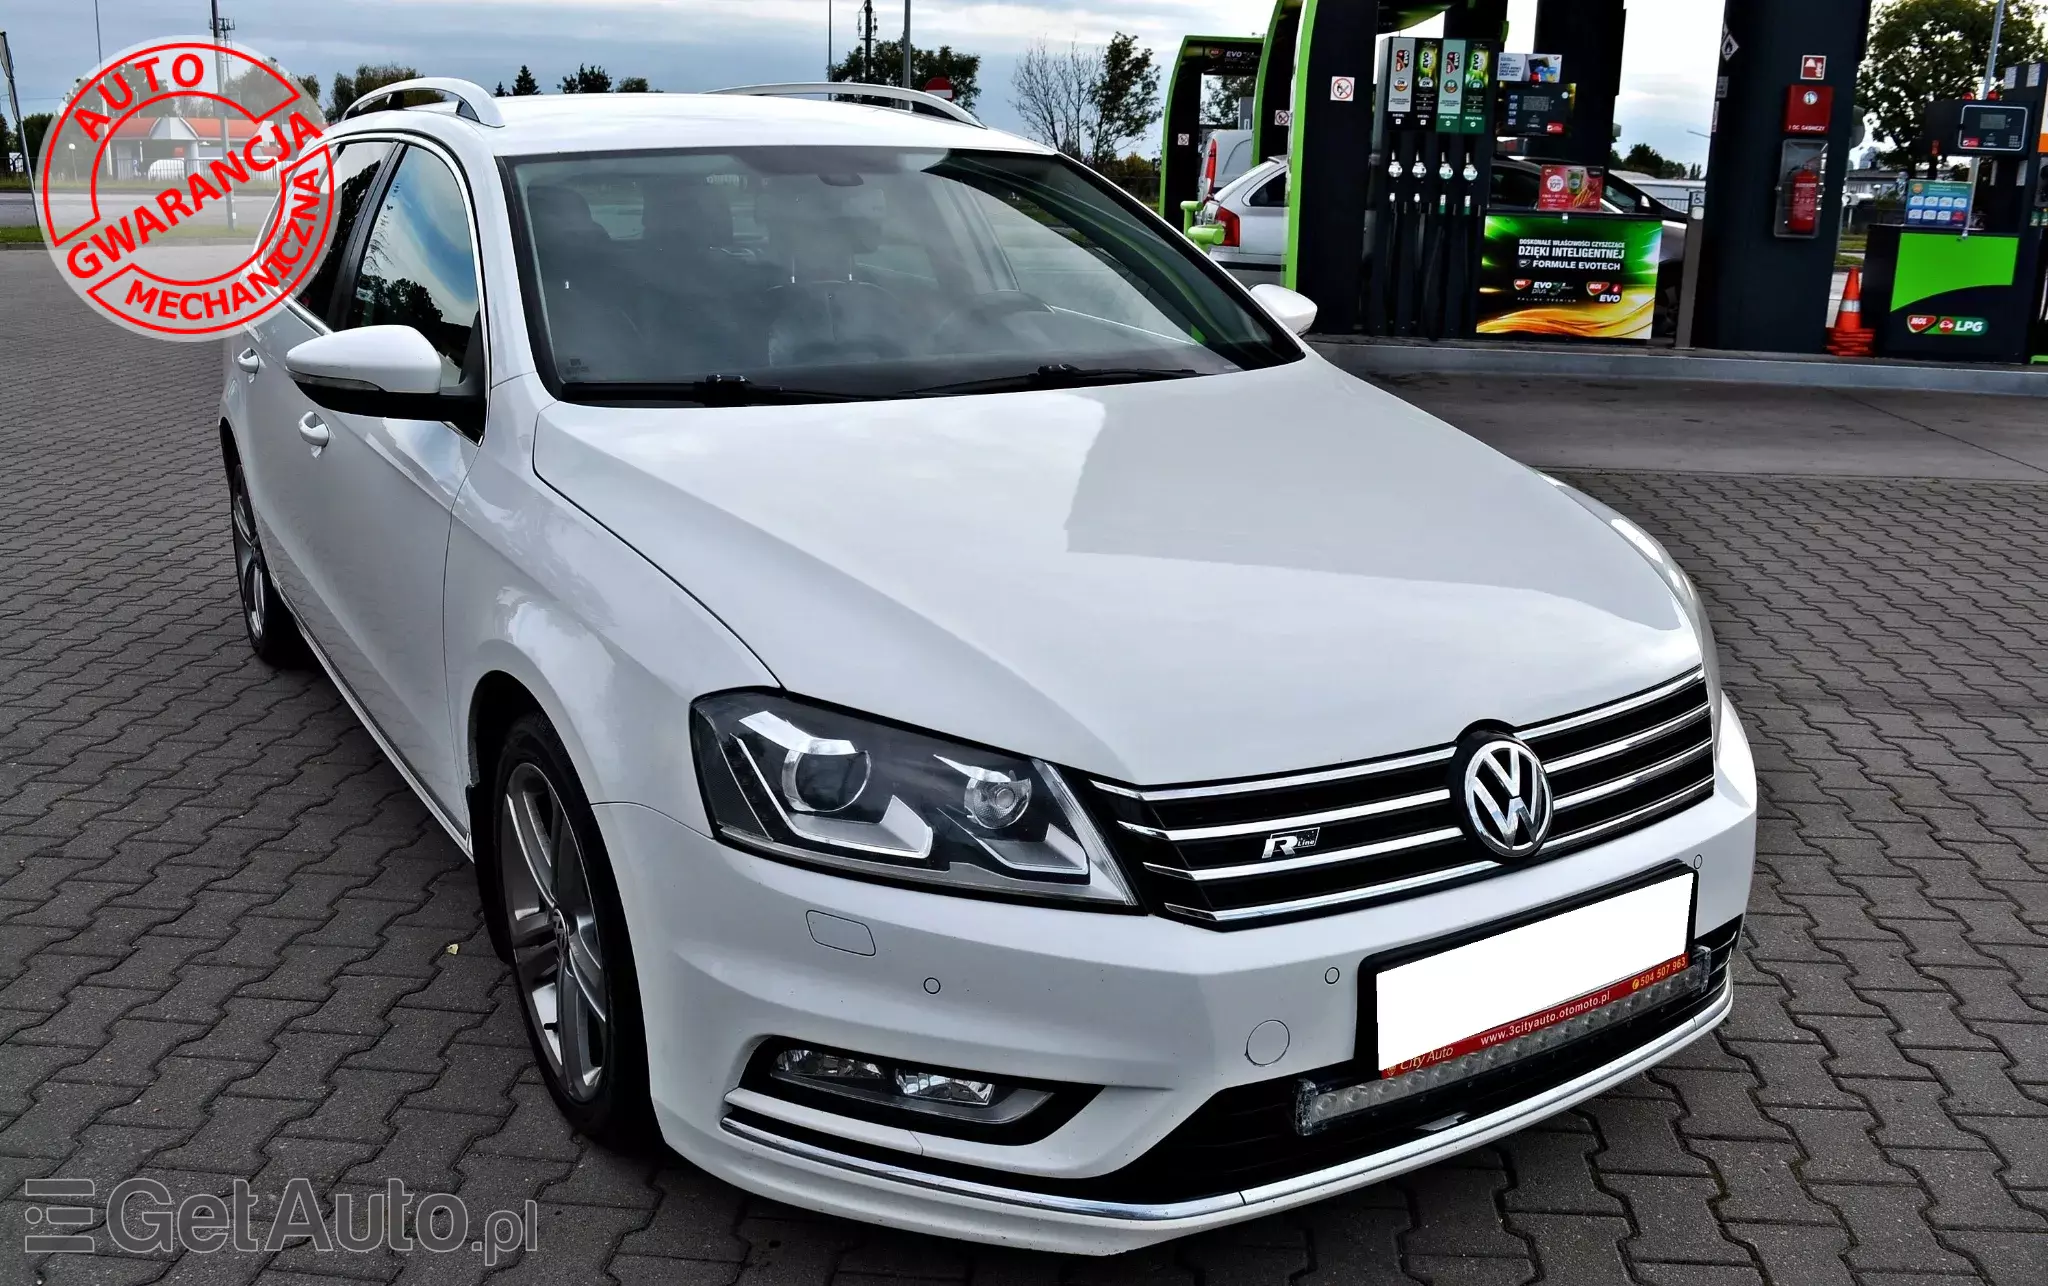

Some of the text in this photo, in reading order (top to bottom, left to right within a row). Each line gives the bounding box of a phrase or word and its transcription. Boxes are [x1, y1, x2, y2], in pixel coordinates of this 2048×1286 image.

[1518, 246, 1624, 259] DZIĘKI INTELIGENTNEJ
[1533, 260, 1576, 269] FORMULE
[1578, 261, 1621, 270] EVOTECH
[1955, 321, 1983, 332] LPG
[1400, 957, 1686, 1070] City Auto www.3cityauto.otomoto.pl 504 507 963
